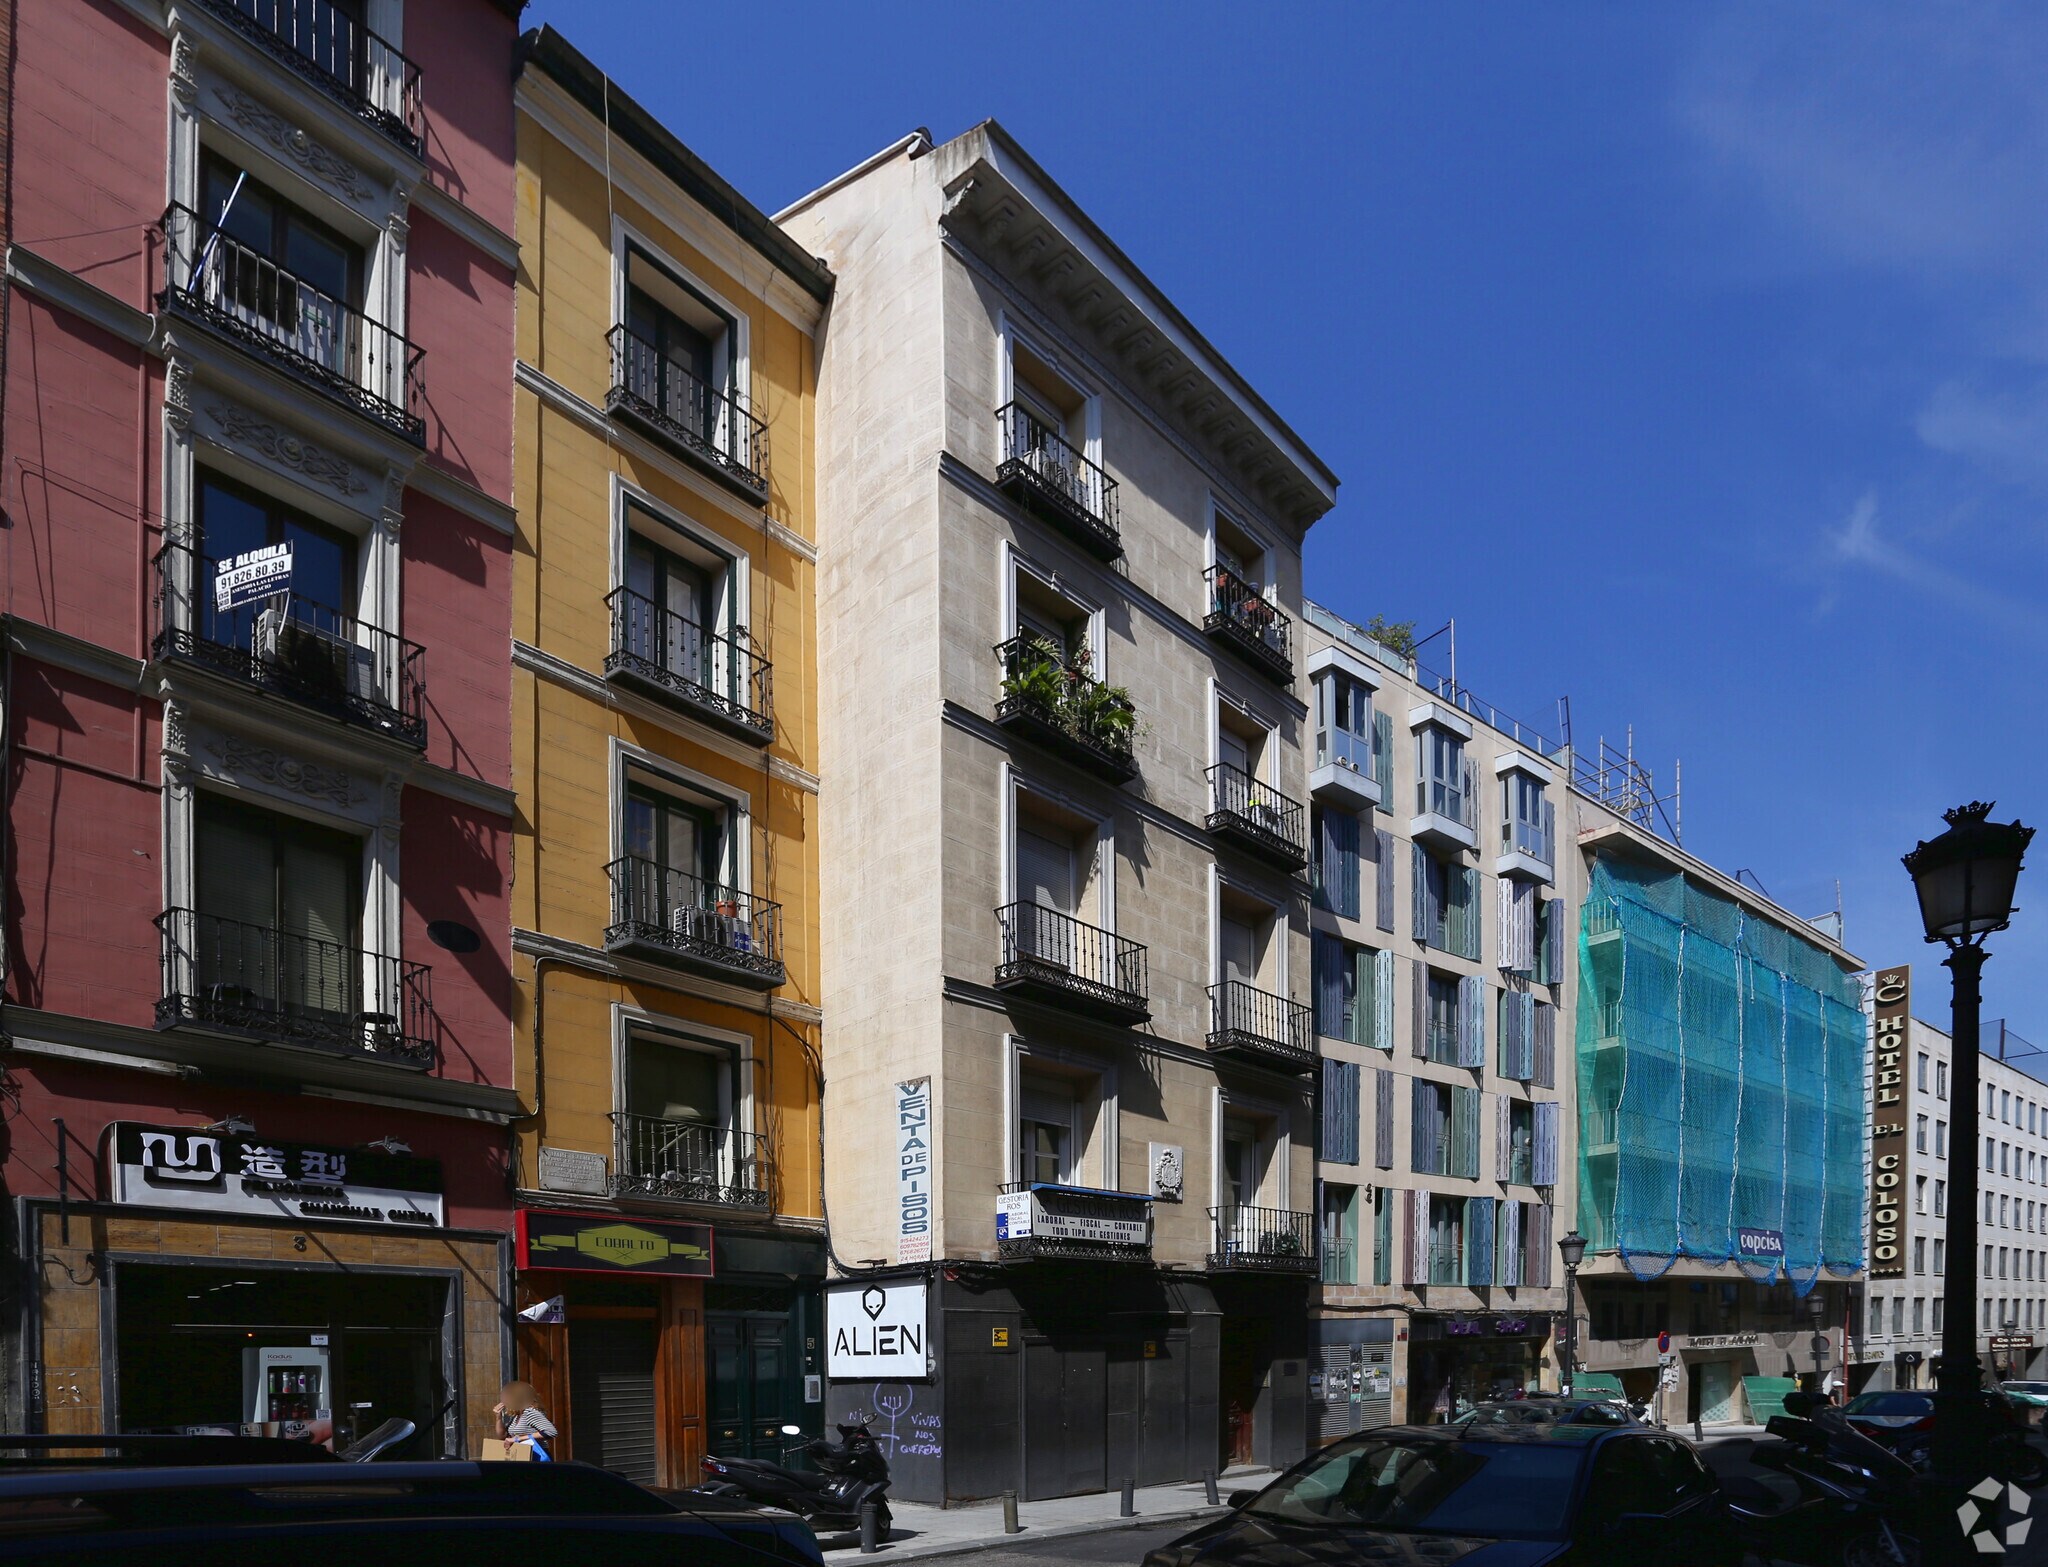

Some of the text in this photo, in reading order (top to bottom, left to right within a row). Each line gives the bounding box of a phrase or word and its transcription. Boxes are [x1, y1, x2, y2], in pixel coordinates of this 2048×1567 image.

[218, 543, 287, 574] SE ALQUILA
[221, 560, 285, 589] 91.826.80.39
[1877, 1015, 1904, 1103] HOTEL
[1874, 1123, 1904, 1135] EL
[240, 1143, 346, 1186] 造型
[900, 1085, 928, 1235] VENTA DE PISOS
[998, 1194, 1029, 1204] GESTORIA
[1006, 1202, 1021, 1210] ROS
[1875, 1154, 1899, 1260] COLOSO
[299, 1201, 435, 1222] SHANGHAI CHINA
[1057, 1200, 1141, 1221] GESTORIA ROS
[1037, 1214, 1143, 1232] LABORAL FISCAL CONTABLE
[1052, 1227, 1131, 1241] TODO TIPO DE GESTIONES
[293, 1236, 307, 1251] 3
[596, 1237, 655, 1250] COBALTO
[1495, 1320, 1527, 1334] SHOP
[807, 1337, 815, 1349] 5
[834, 1324, 921, 1356] ALIEN
[915, 1430, 936, 1442] NOS
